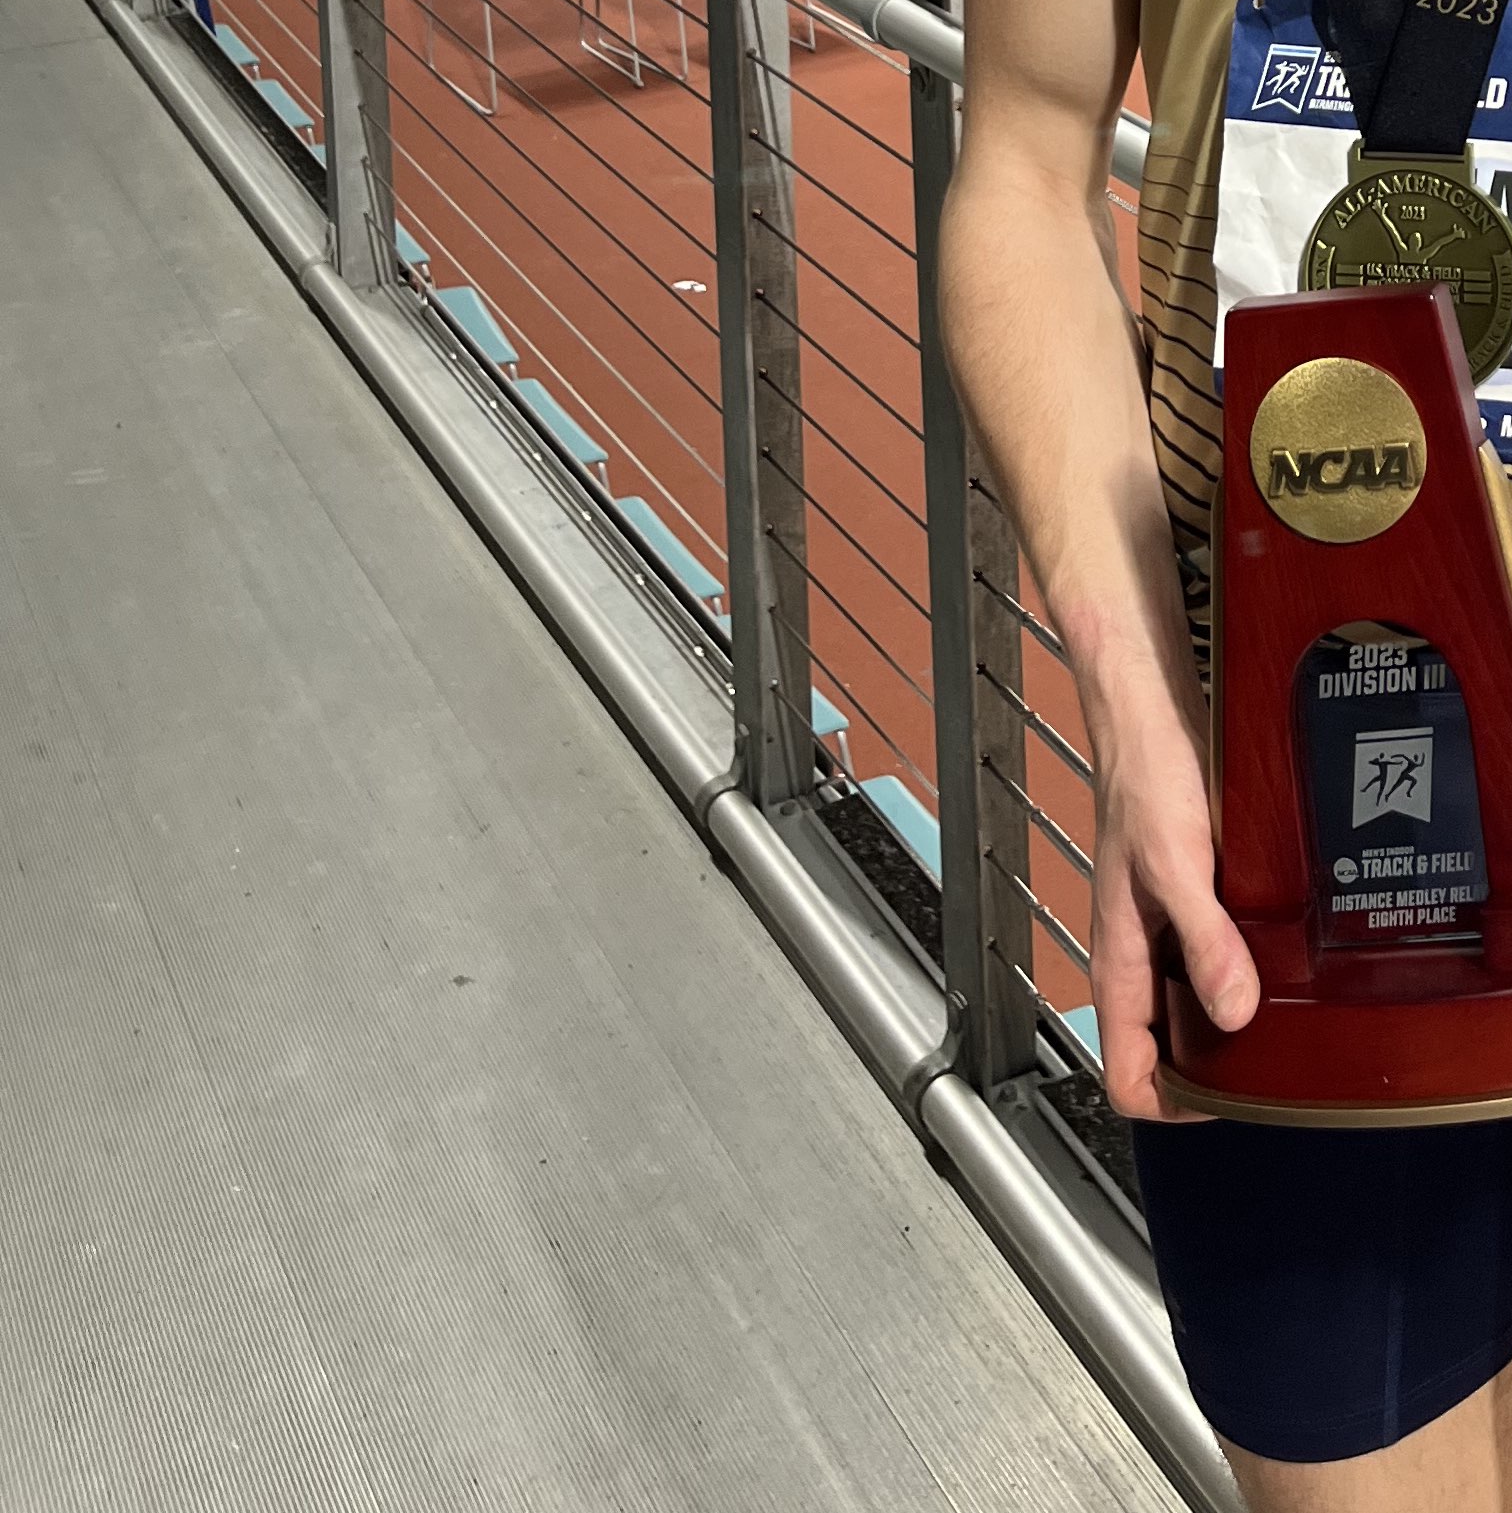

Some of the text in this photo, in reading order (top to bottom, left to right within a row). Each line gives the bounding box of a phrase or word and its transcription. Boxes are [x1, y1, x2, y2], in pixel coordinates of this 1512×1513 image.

[1333, 173, 1498, 235] ALL-AMERICAN
[1268, 441, 1417, 498] NCAA
[1349, 642, 1408, 670] 2023
[1318, 663, 1446, 700] DIVISION III
[1361, 856, 1414, 879] TRACK
[1431, 851, 1475, 874] FIELD
[1332, 885, 1474, 912] DISTANCE MEDLEY REL
[1368, 906, 1457, 929] EIGHTH PLACE
